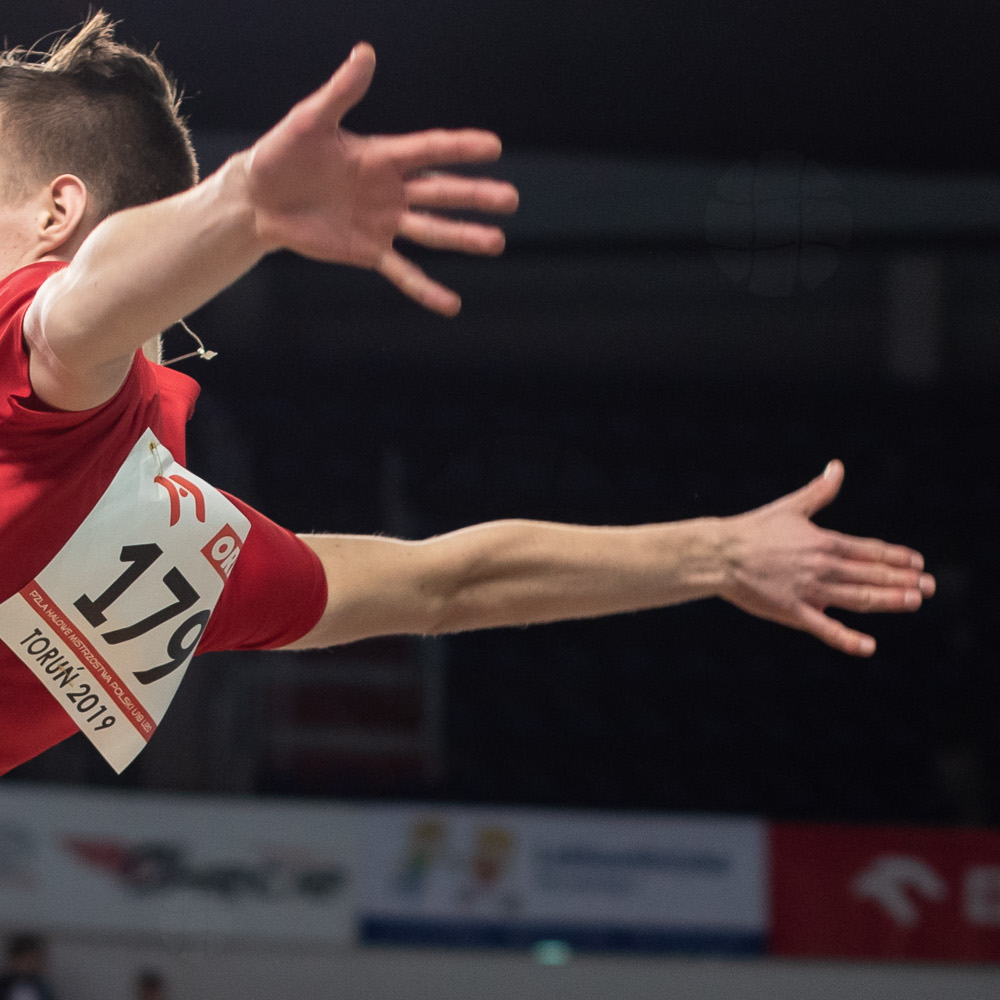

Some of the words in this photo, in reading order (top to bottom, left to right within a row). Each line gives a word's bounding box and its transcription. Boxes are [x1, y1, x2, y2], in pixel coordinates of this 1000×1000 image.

[29, 589, 48, 611] PZLA
[46, 608, 73, 636] HALOWE
[68, 633, 112, 683] MISTRZOSTWA
[109, 681, 136, 710] POLSKI
[73, 543, 211, 685] 179
[20, 627, 85, 688] TORUŃ
[66, 683, 116, 731] 2019
